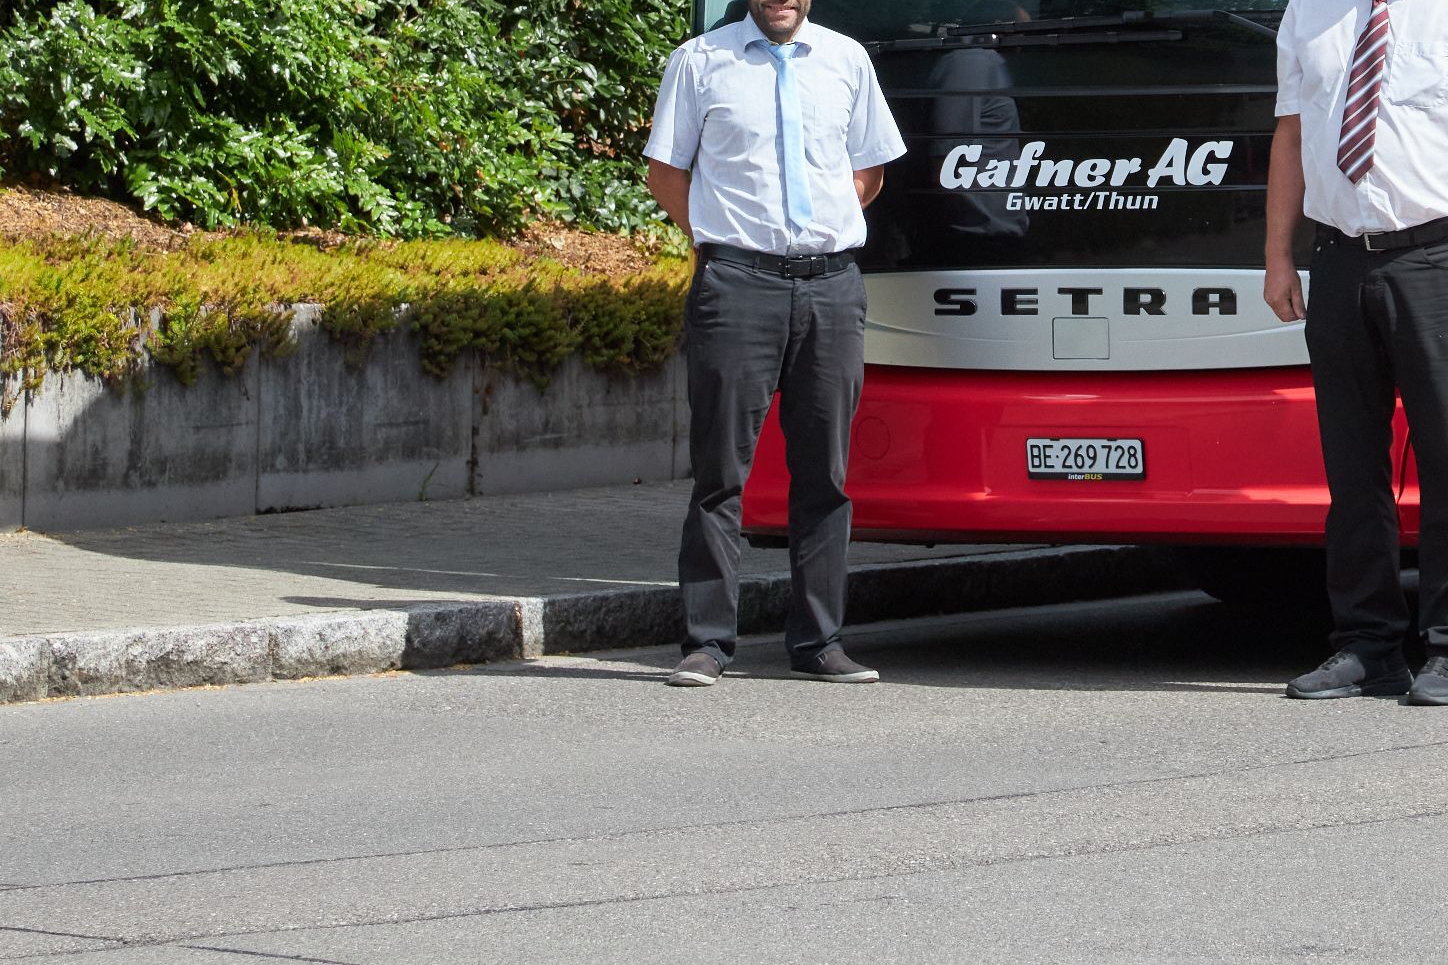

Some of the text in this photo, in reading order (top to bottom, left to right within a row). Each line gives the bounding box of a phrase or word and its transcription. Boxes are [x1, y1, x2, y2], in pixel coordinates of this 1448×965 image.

[939, 137, 1234, 189] Gafner AG
[1006, 191, 1159, 211] Gwatt/Thun
[933, 287, 1238, 316] SETRA
